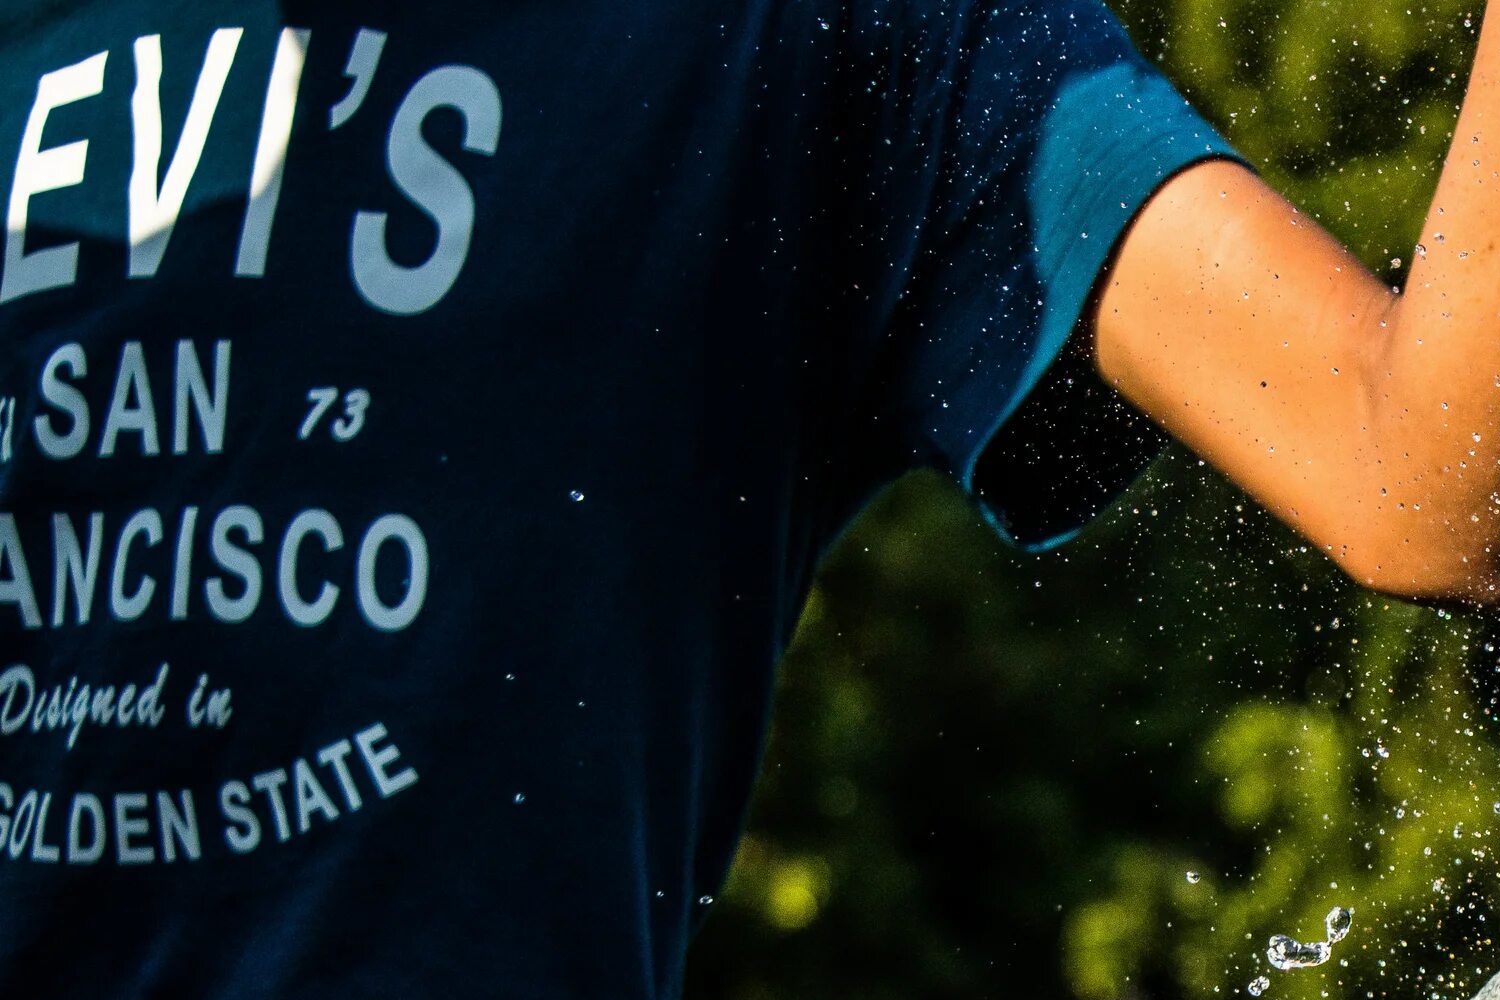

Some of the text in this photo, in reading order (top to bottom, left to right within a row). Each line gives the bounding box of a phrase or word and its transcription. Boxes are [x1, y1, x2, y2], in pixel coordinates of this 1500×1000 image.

[34, 339, 232, 460] SAN
[299, 386, 371, 443] 73
[0, 663, 233, 751] Designed in
[219, 722, 419, 855] STATE
